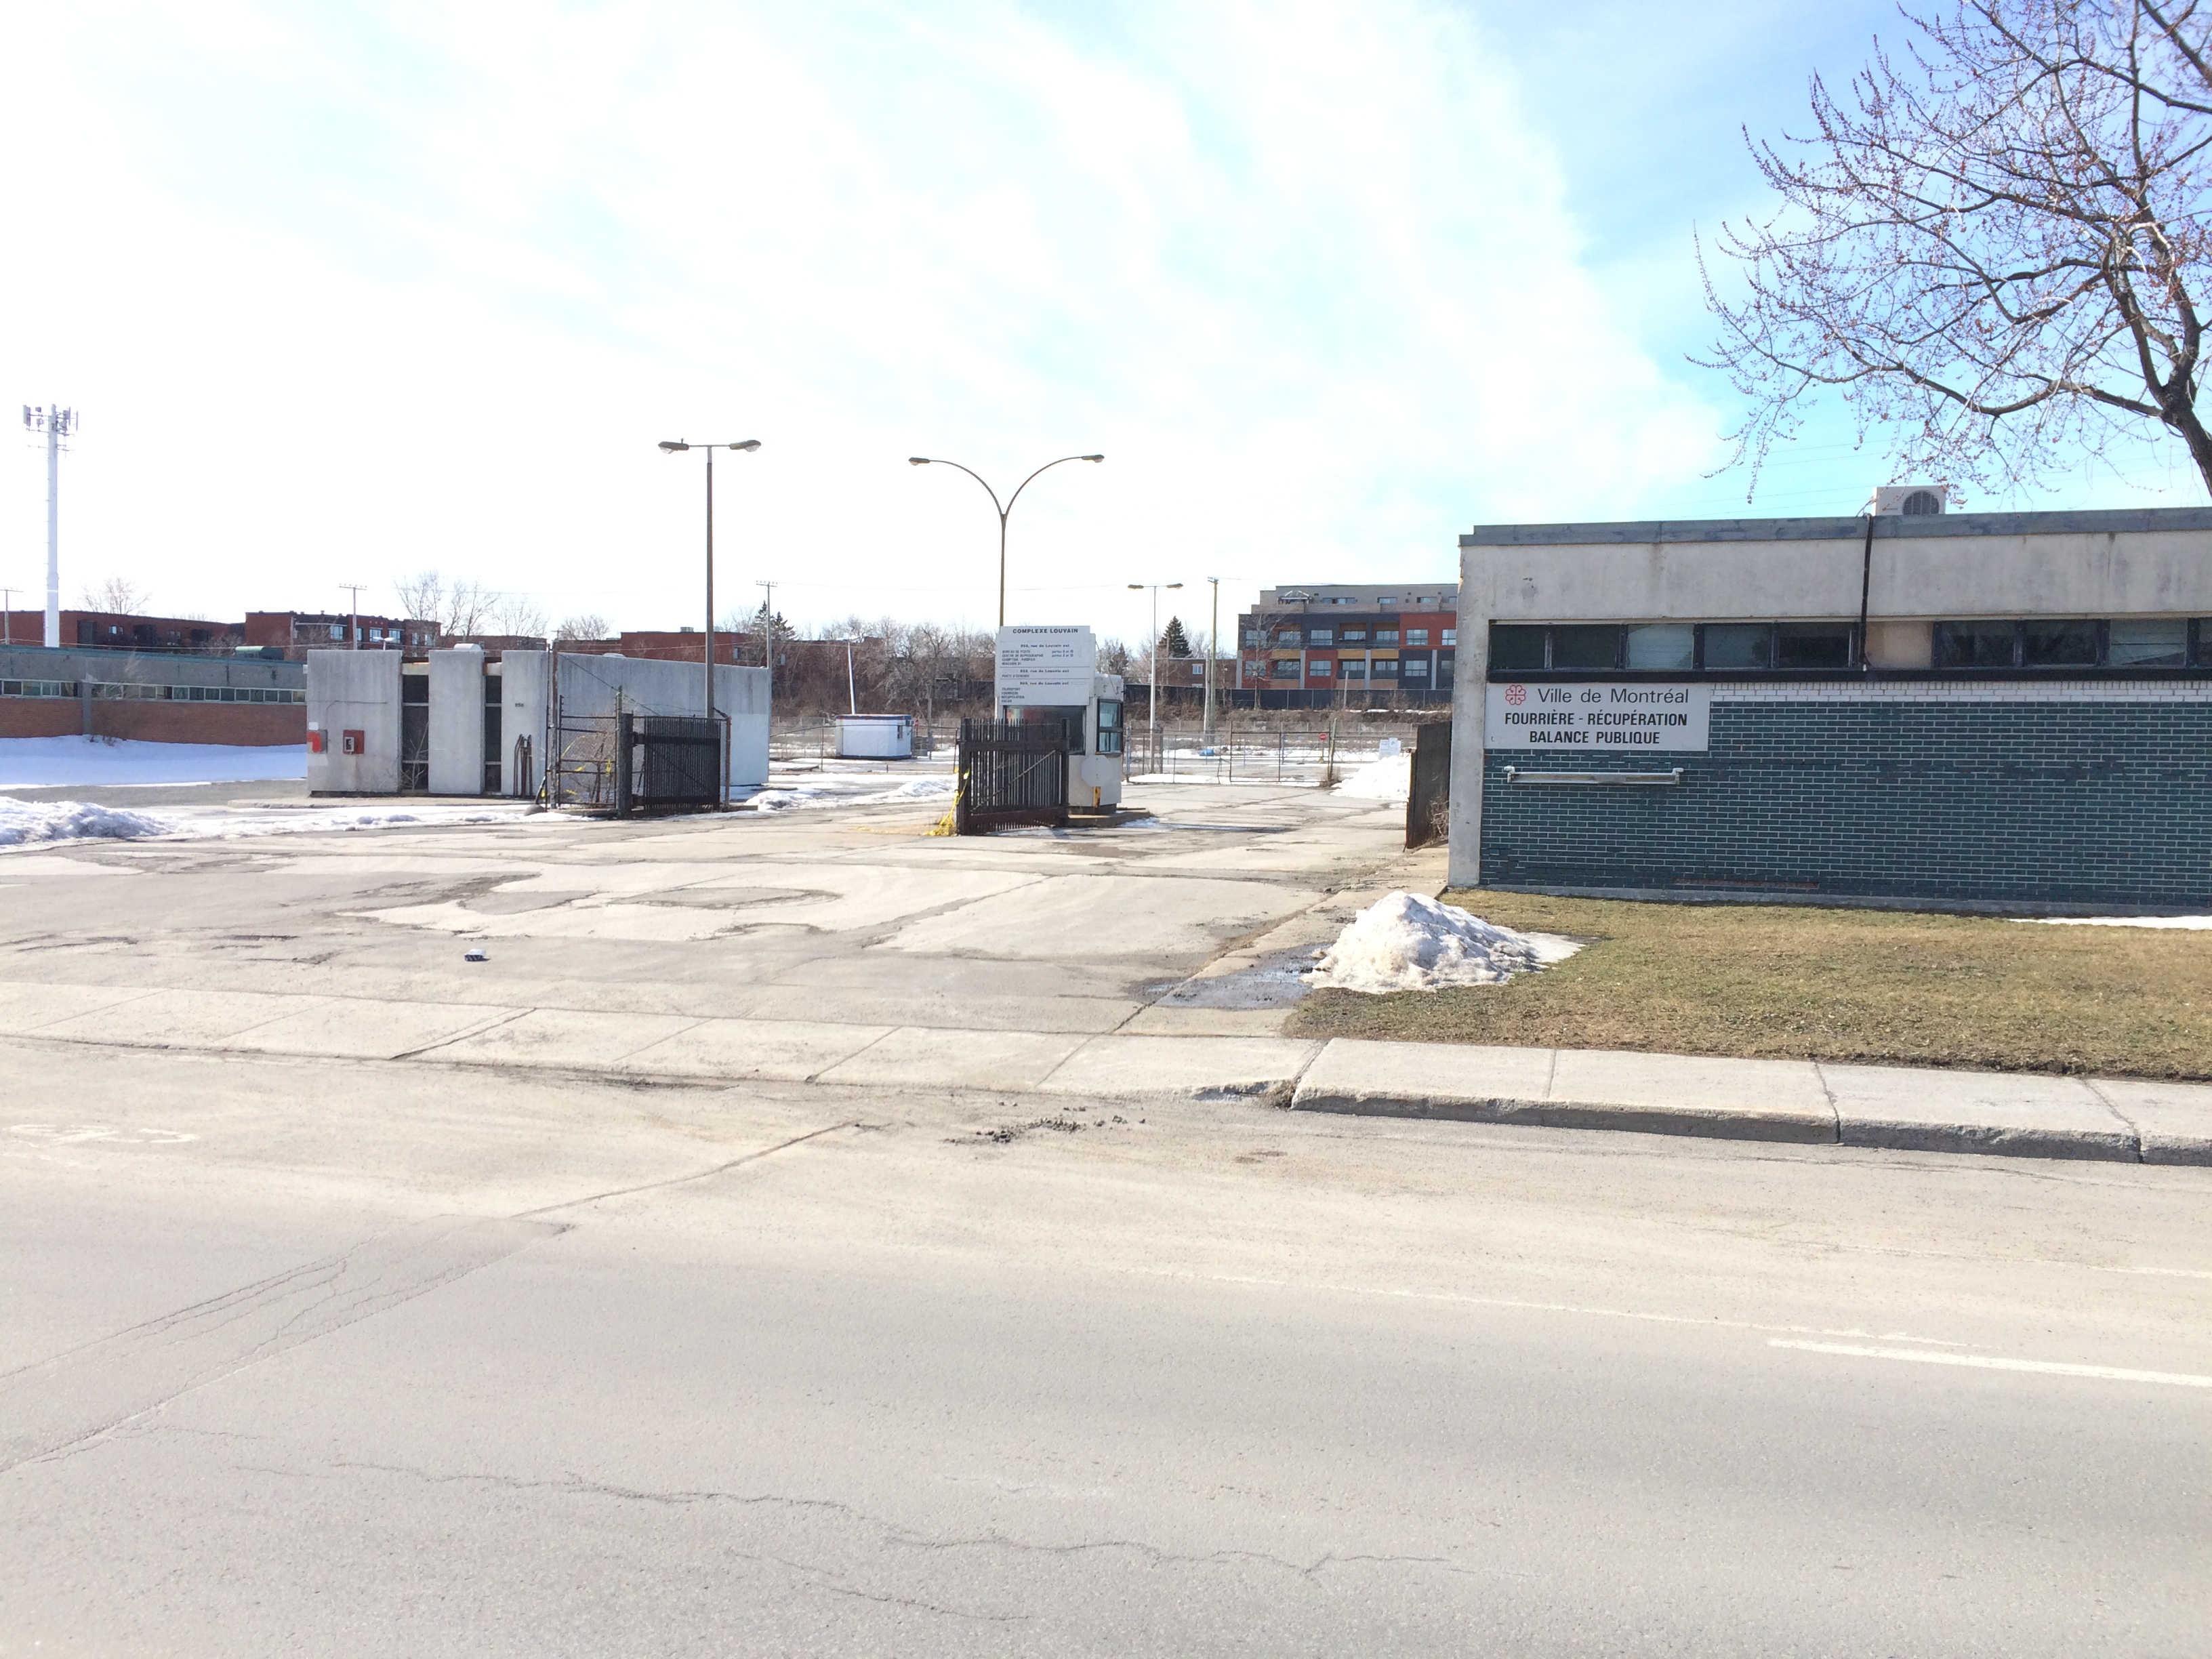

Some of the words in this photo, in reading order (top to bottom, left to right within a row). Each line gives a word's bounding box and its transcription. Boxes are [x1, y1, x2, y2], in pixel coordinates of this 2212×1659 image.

[1538, 688, 1572, 703] Ville
[1580, 688, 1601, 703] de
[1610, 688, 1689, 703] Montréal
[1504, 709, 1574, 725] FOURRIÈRE
[1587, 709, 1687, 726] RÉCUPÉRATION
[1530, 731, 1589, 743] BALANCE
[1596, 731, 1660, 744] PUBLIQUE
